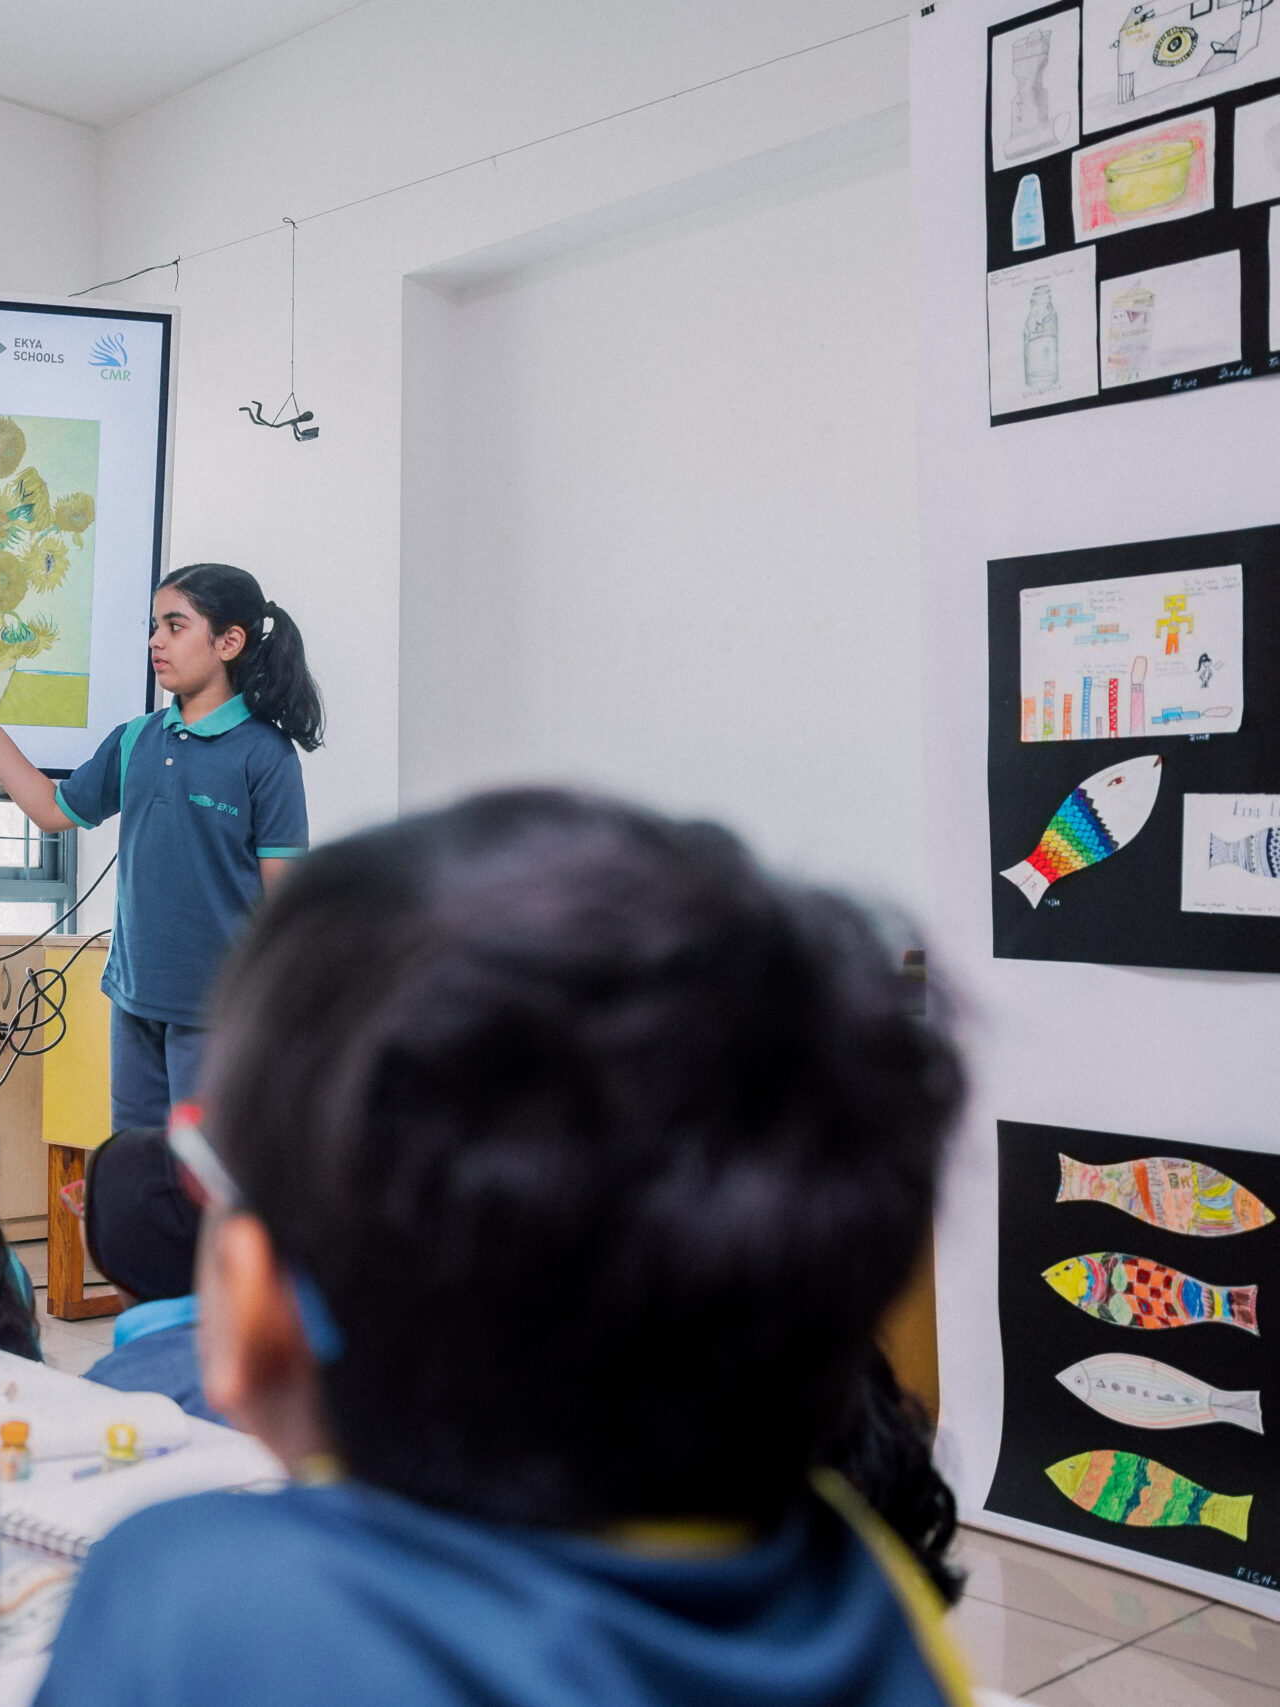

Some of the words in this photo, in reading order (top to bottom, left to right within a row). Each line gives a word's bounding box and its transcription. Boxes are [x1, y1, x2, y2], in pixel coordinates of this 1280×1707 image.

[14, 338, 42, 349] EKYA
[13, 351, 64, 364] SCHOOLS
[100, 368, 130, 382] CMR
[217, 802, 238, 816] EKYA
